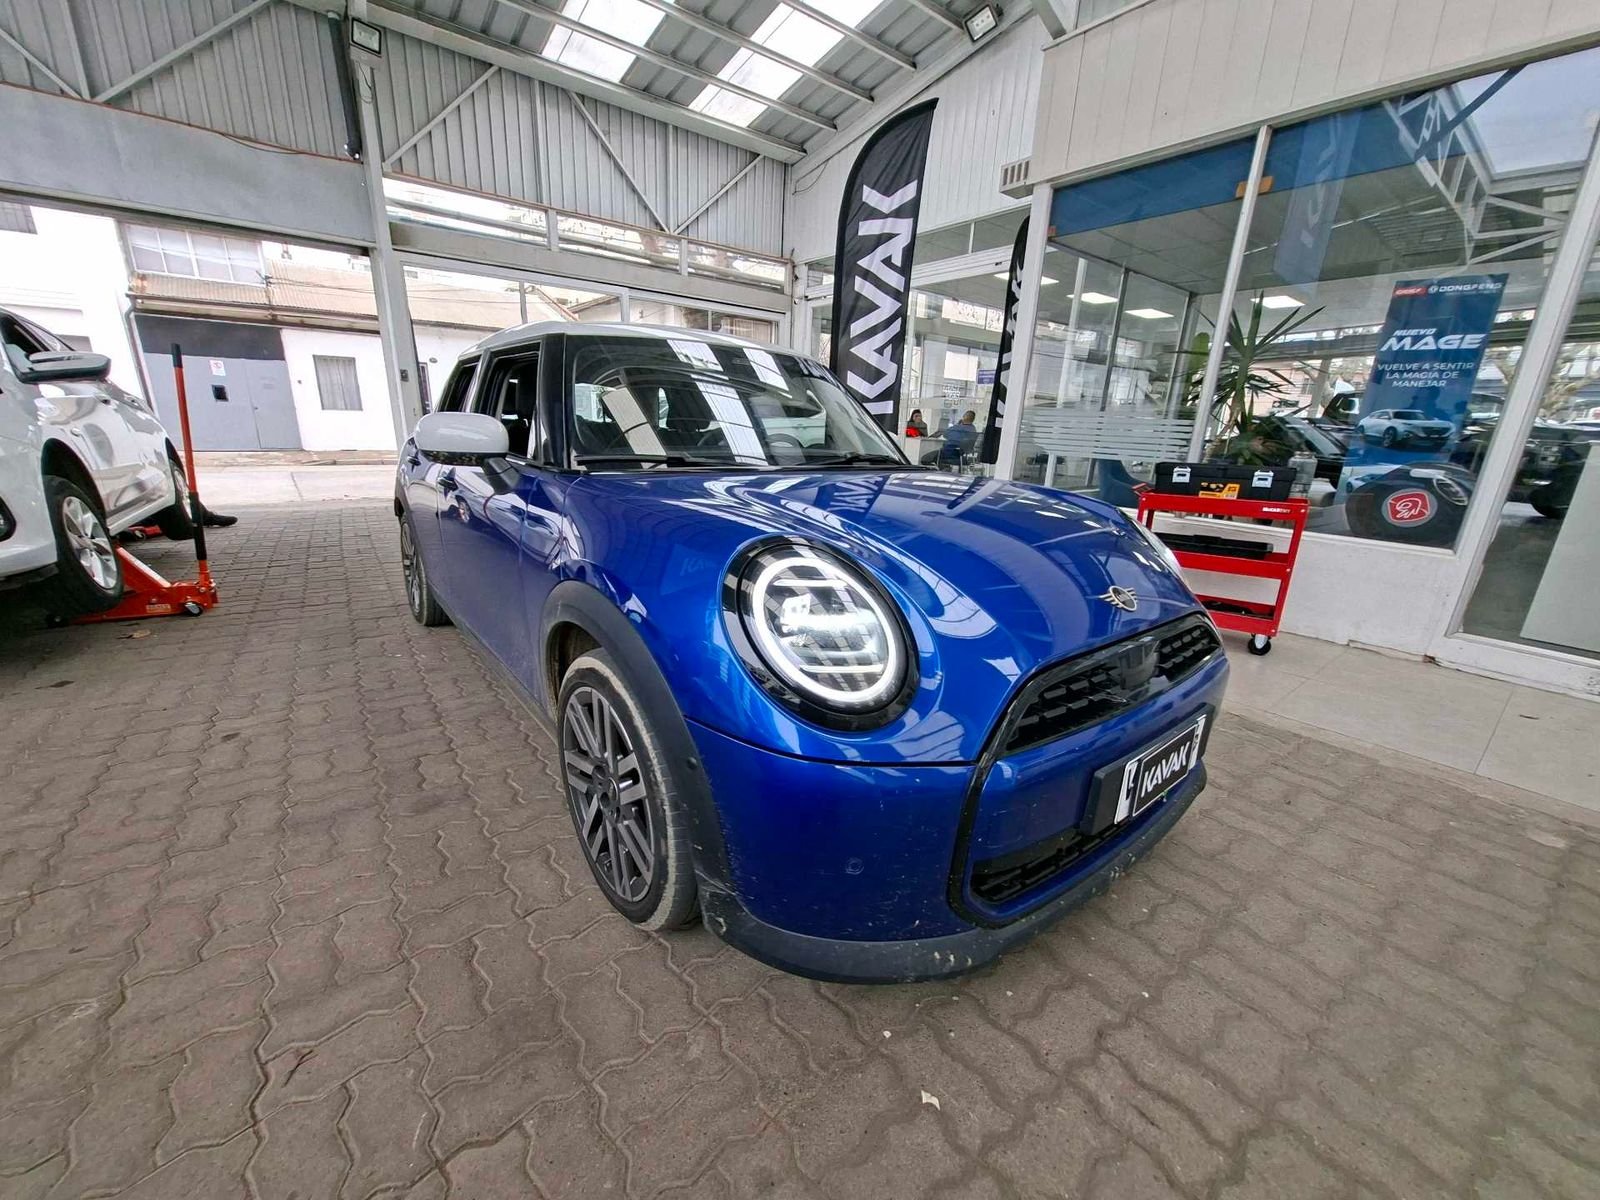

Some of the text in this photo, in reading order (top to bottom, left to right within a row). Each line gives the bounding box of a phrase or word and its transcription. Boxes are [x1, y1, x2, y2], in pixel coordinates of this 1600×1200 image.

[1439, 282, 1503, 293] DONGFENG
[847, 180, 918, 415] KAVAK
[1392, 328, 1438, 336] NUEVO
[1380, 334, 1488, 351] MAGE
[1378, 363, 1420, 371] VUELVE
[1402, 371, 1439, 379] MAGIA
[1140, 741, 1192, 798] KAVAK
